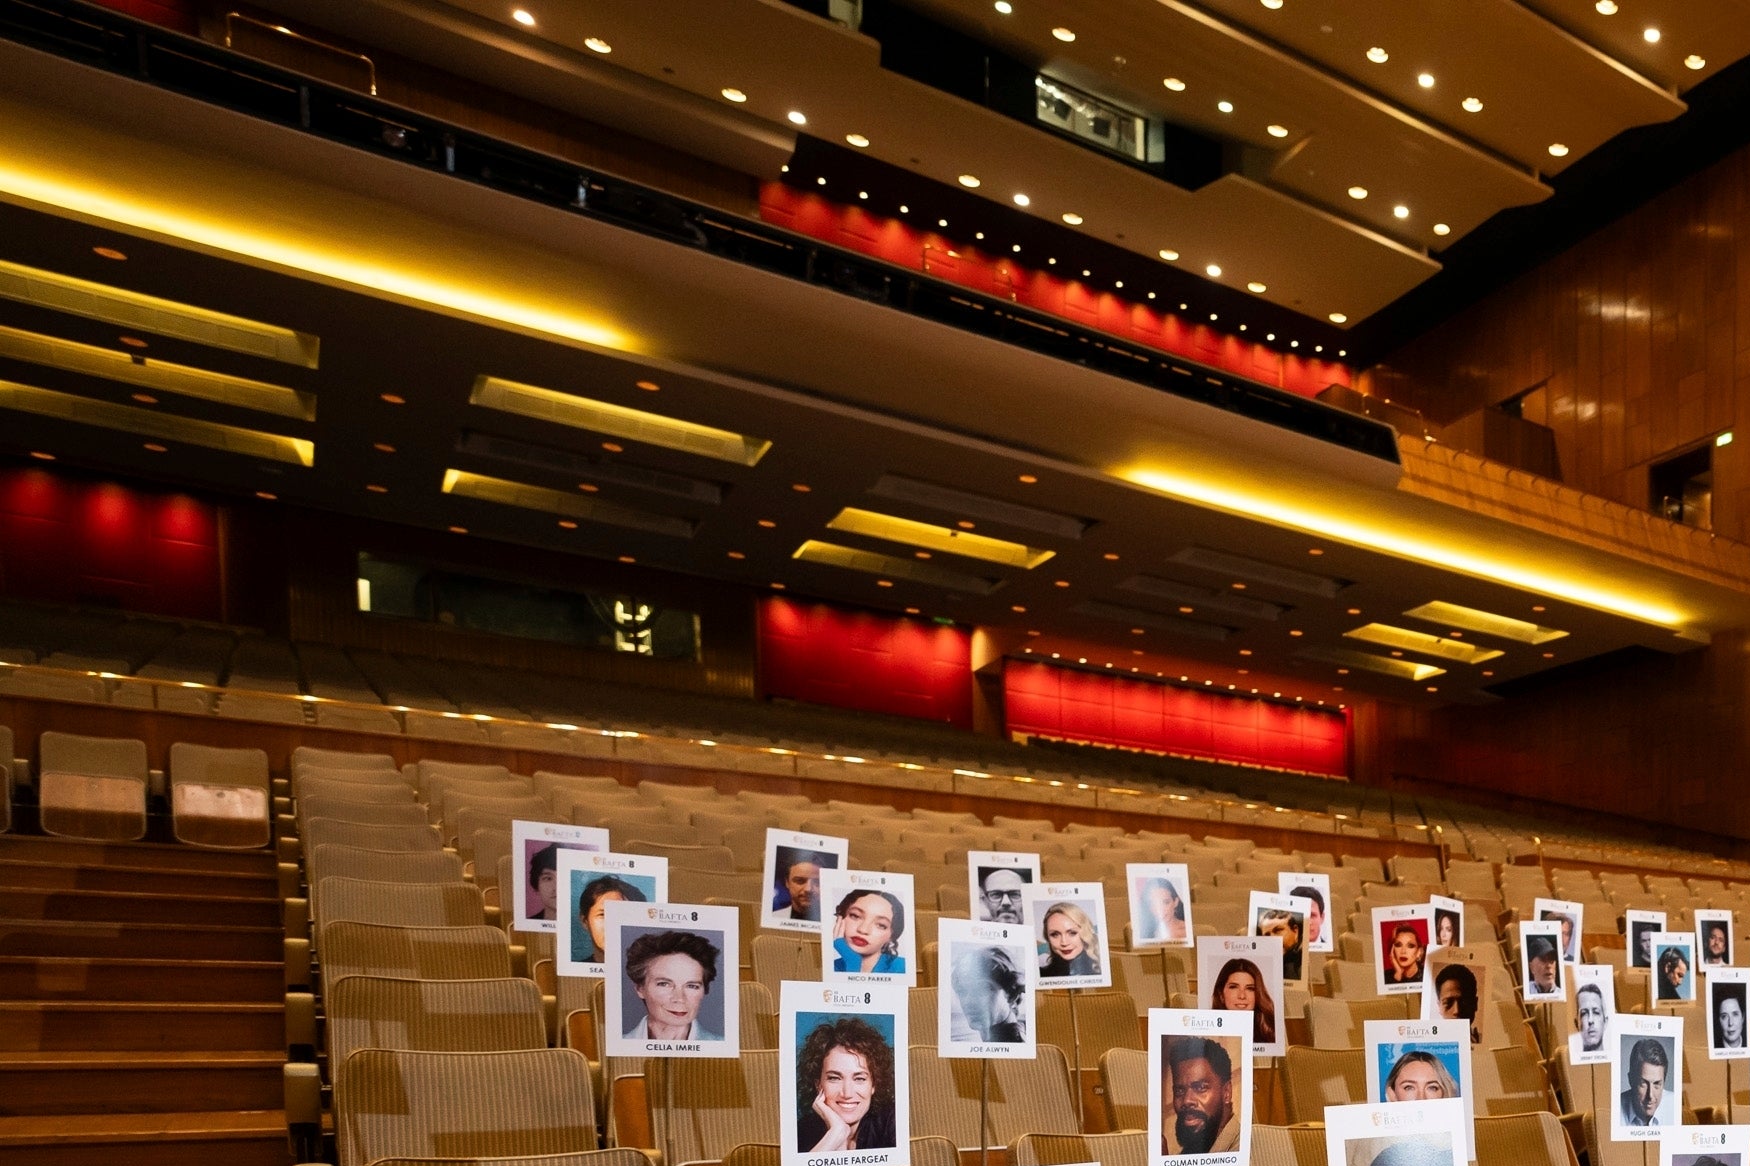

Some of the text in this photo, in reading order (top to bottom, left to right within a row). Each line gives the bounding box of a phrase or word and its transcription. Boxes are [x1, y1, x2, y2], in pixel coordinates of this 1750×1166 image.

[659, 912, 688, 921] BAFTA
[1191, 1019, 1214, 1027] BAFTA
[646, 1043, 701, 1052] CELIA IMRIE
[851, 1154, 889, 1165] FARGEAT
[1200, 1156, 1237, 1166] DOMINGO
